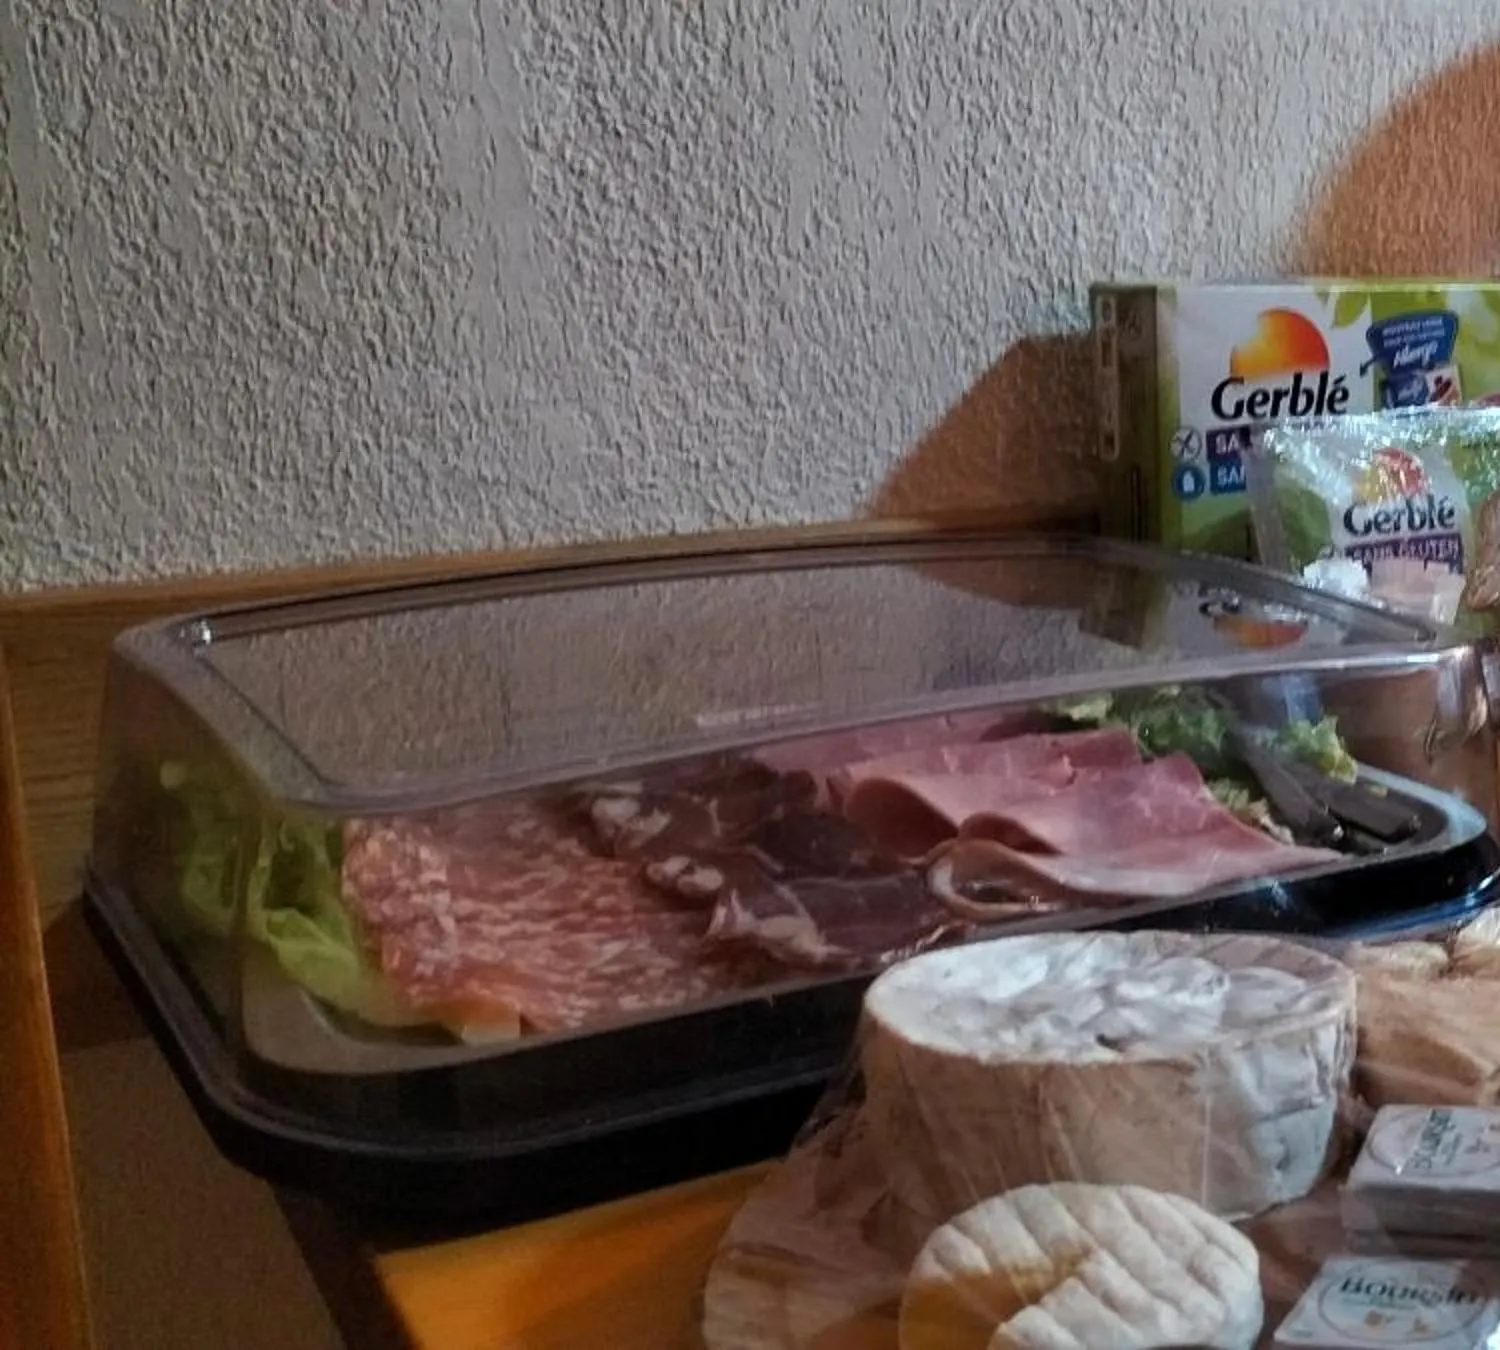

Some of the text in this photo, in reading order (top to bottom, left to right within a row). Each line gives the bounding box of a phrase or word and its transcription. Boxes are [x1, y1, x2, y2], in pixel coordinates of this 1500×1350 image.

[1211, 370, 1350, 421] Gerblé
[1343, 493, 1456, 536] Gerblé
[1339, 1276, 1479, 1310] Boursin
